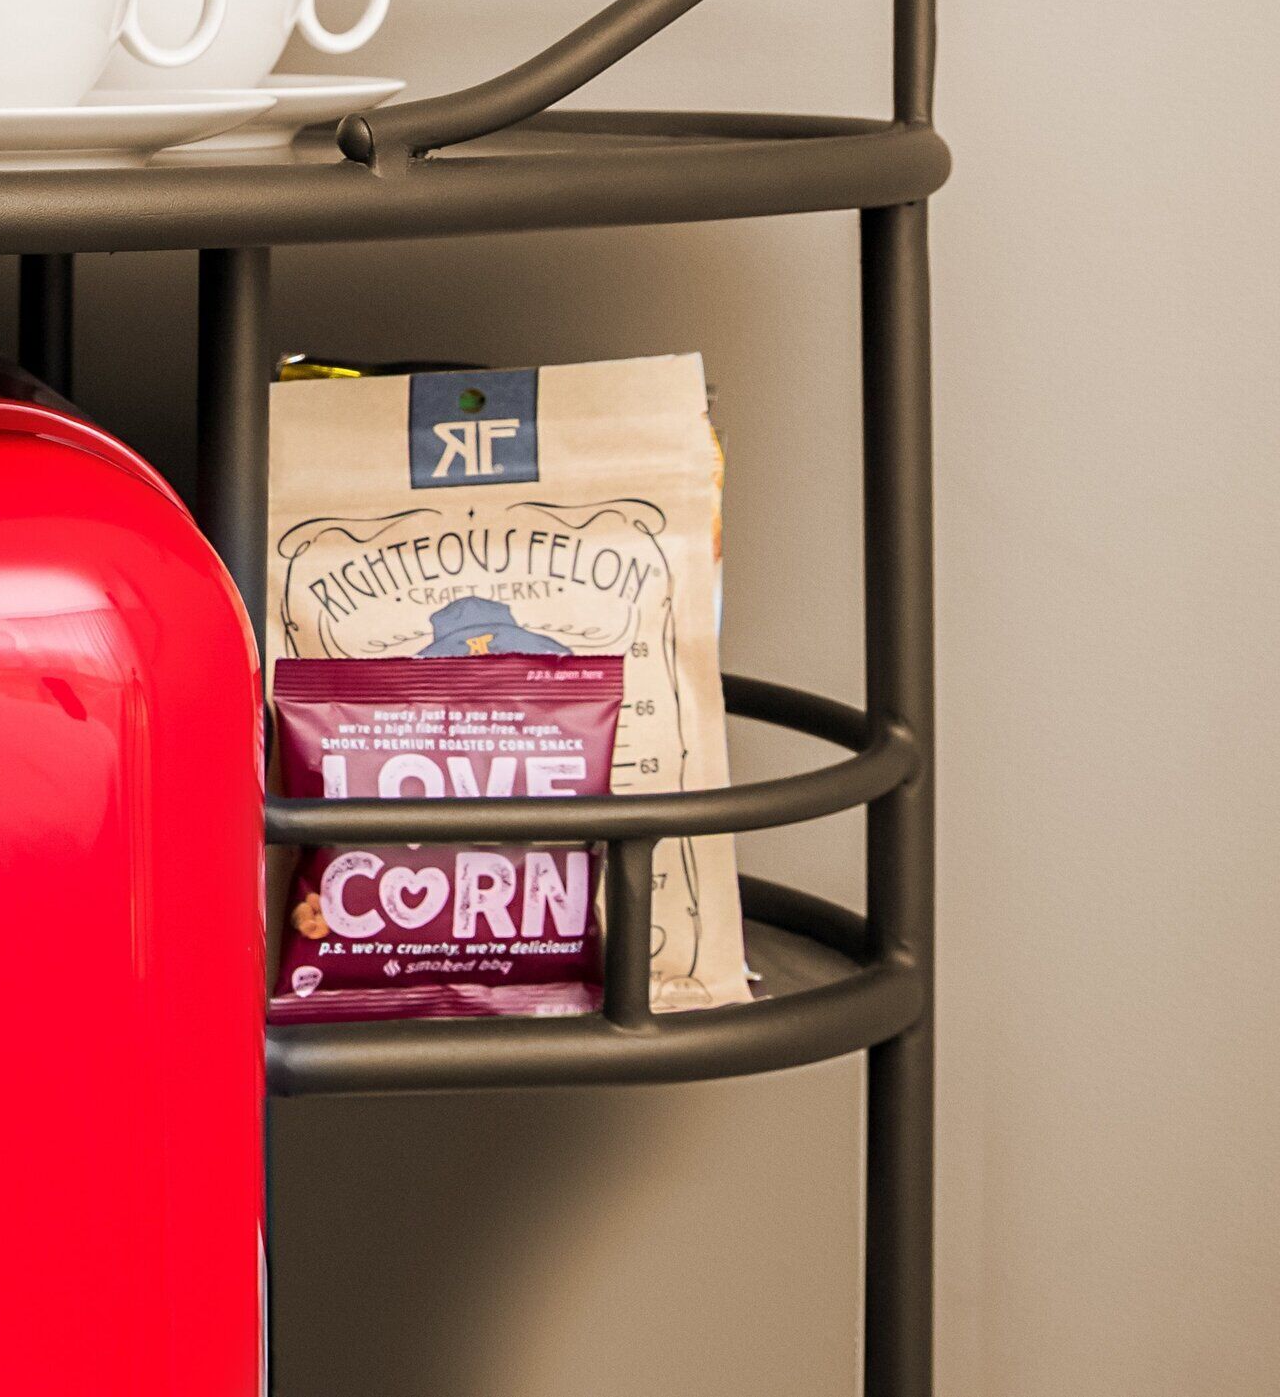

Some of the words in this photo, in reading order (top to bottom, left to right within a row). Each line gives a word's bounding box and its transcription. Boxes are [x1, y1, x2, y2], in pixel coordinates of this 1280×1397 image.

[308, 528, 517, 623] RIGHTEOUS
[528, 530, 651, 604] FELON
[635, 700, 655, 716] 66
[374, 738, 435, 751] PREMIUM
[438, 739, 495, 752] ROASTED
[498, 739, 536, 752] CORN
[539, 739, 584, 752] SNACK
[640, 758, 660, 774] 63
[352, 942, 393, 954] we're
[465, 941, 508, 954] we're
[509, 940, 584, 954] delicious!
[404, 959, 476, 974] smoked
